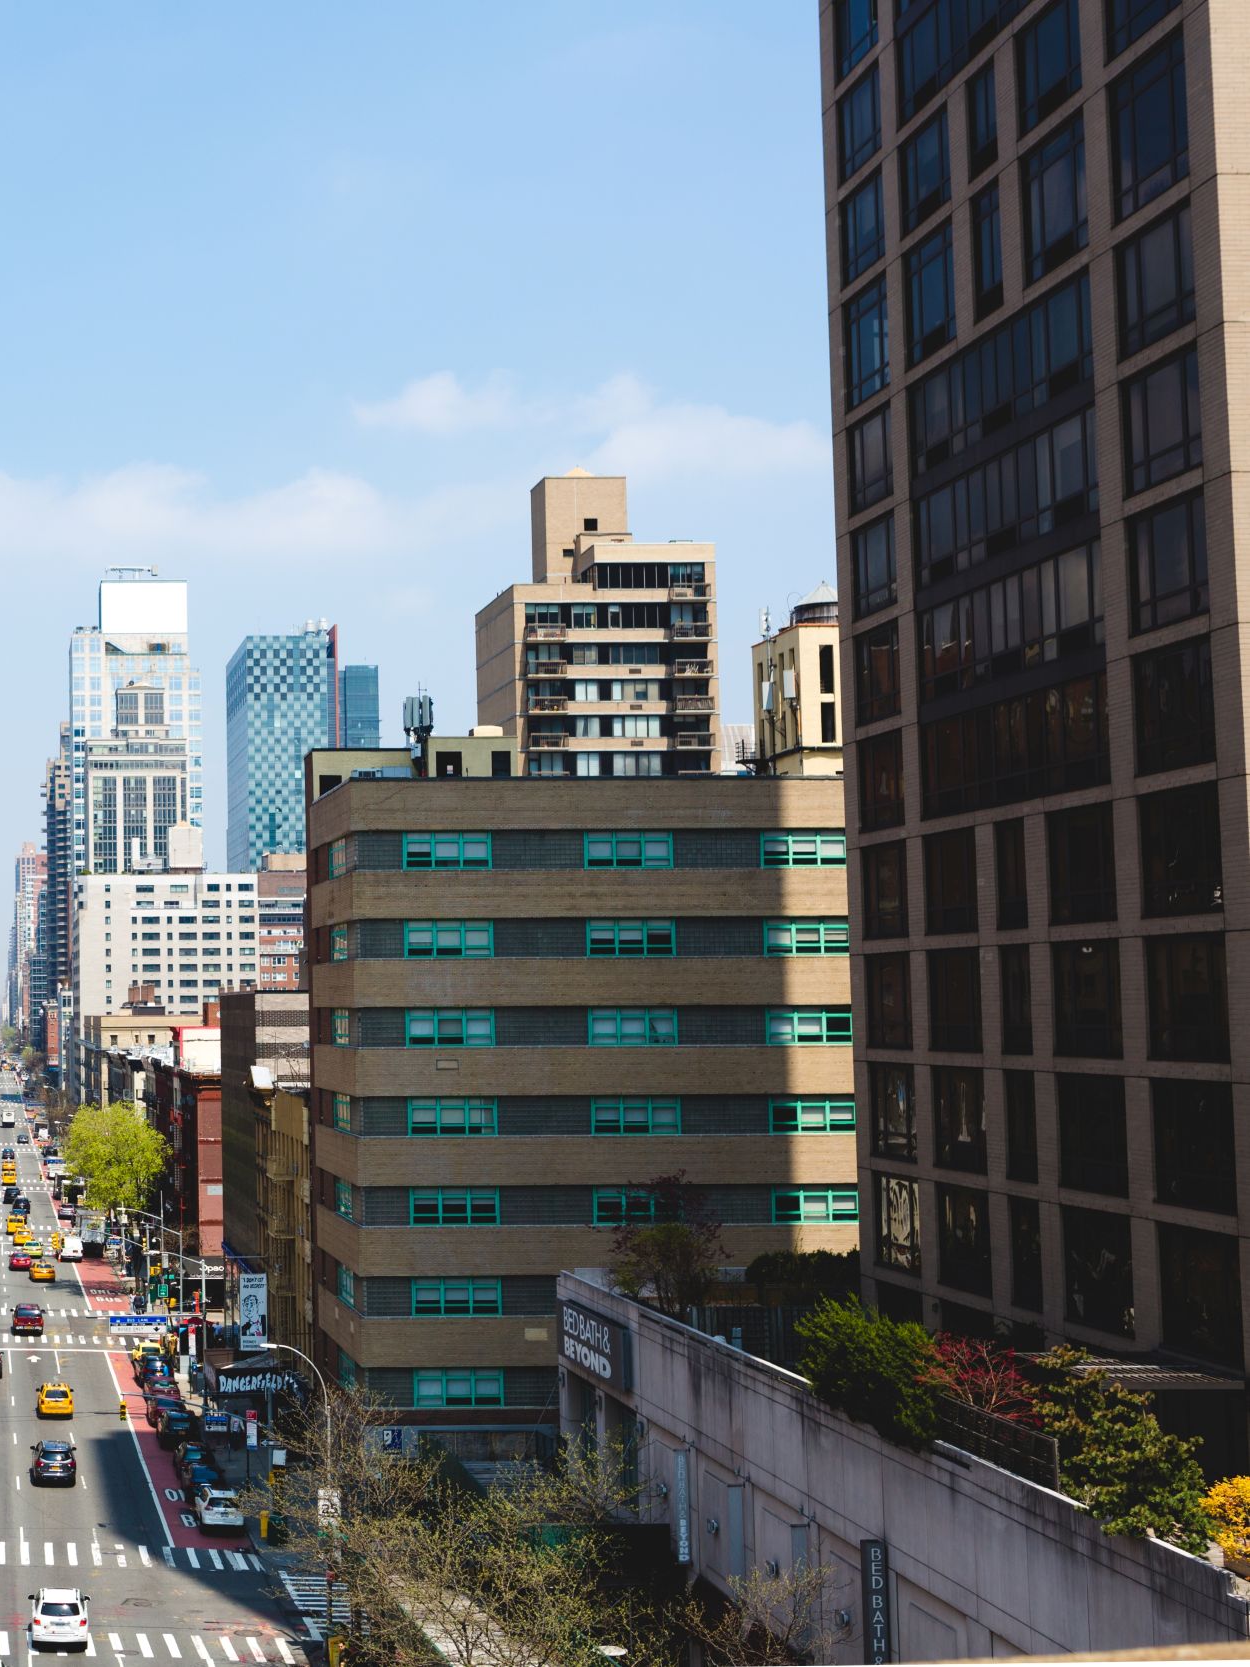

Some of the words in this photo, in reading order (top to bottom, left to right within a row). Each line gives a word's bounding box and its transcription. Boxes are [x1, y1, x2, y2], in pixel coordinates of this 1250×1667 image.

[563, 1306, 580, 1336] BED
[579, 1314, 602, 1350] BATH
[603, 1326, 611, 1355] &
[564, 1335, 612, 1379] BEYOND
[678, 1455, 686, 1479] BED
[678, 1481, 687, 1511] BATH
[678, 1519, 690, 1561] BEYOND
[871, 1548, 883, 1589] BED
[872, 1595, 885, 1652] BATH
